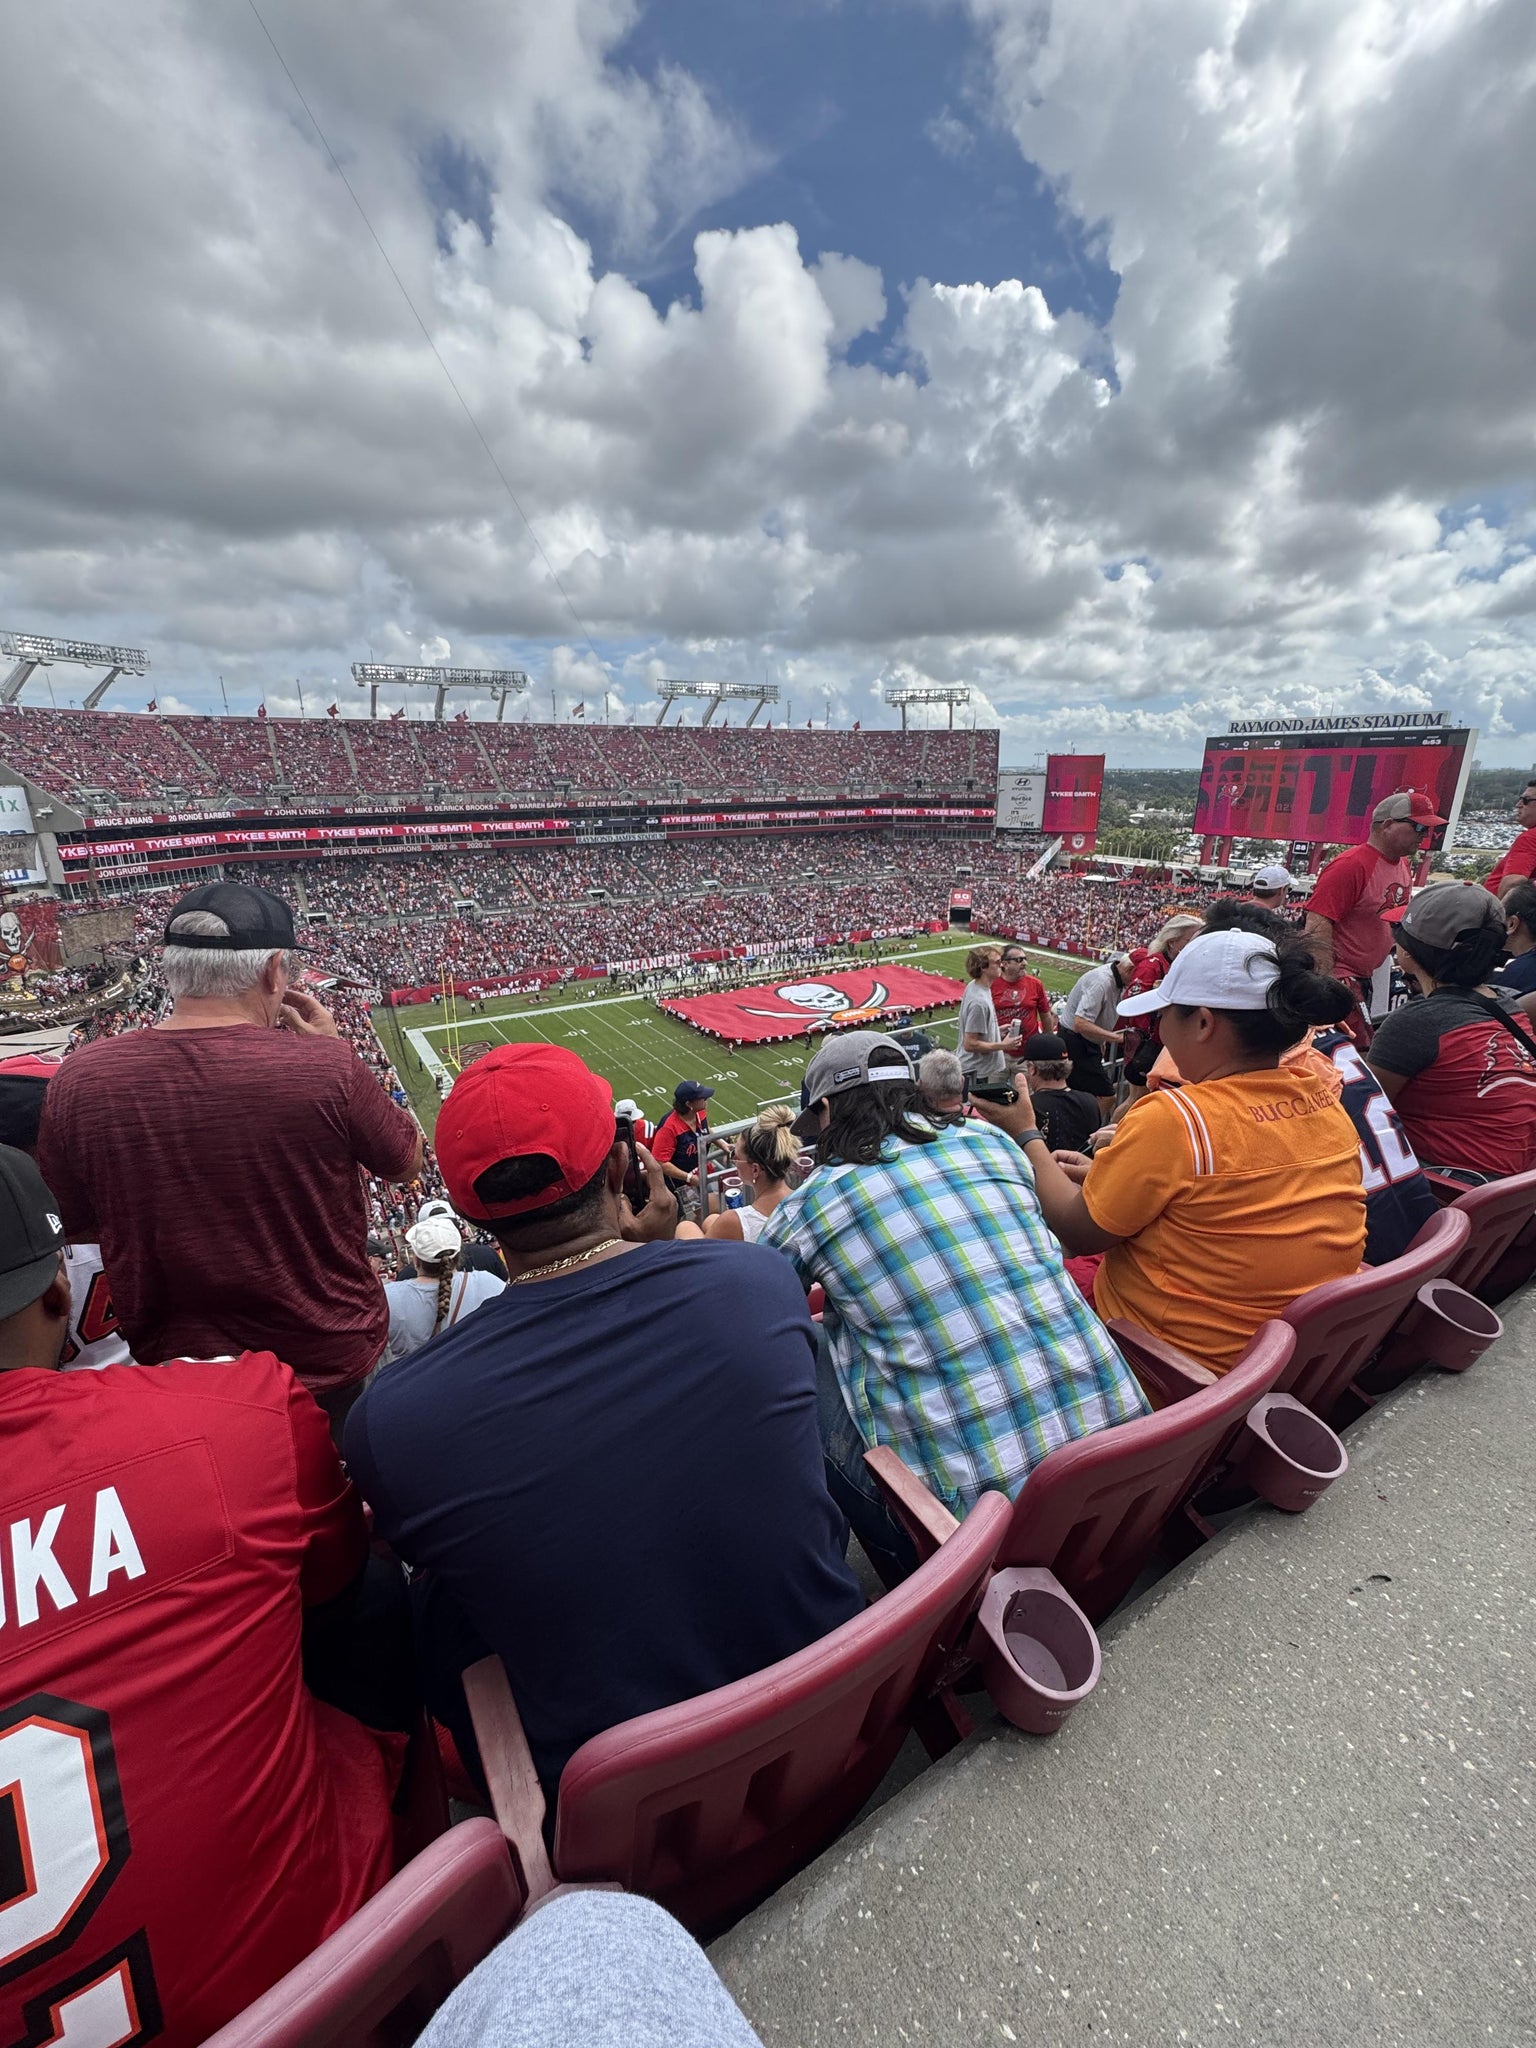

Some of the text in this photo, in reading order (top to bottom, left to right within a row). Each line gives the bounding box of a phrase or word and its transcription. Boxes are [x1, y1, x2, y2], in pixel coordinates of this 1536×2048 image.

[1229, 713, 1445, 734] RAYMOND JAMES STADIUM
[434, 804, 464, 812] DERRICK
[94, 816, 154, 827] BRUCE ARIANS
[178, 813, 203, 821] RONDE
[204, 811, 231, 820] BARBER
[403, 824, 472, 834] TYKEE SMITH
[482, 821, 545, 830] TYKEE SMITH
[225, 830, 306, 841] TYKEE SMITH
[318, 827, 393, 837] TYKEE SMITH
[146, 835, 216, 849] TYKEE SMITH
[577, 832, 666, 844] RAYMOND JAMES STADIUM
[95, 842, 135, 854] SMITH
[322, 849, 350, 857] SUPER
[377, 845, 422, 854] CHAMPIONS
[98, 866, 149, 878] JON GRUDEN
[871, 930, 887, 938] GO
[343, 986, 383, 1000] TAMPA
[480, 990, 498, 999] BUC
[522, 984, 540, 993] LINE
[779, 1056, 804, 1067] 30
[712, 1070, 739, 1081] 20
[641, 1086, 667, 1096] 10
[0, 1486, 146, 1631] KA
